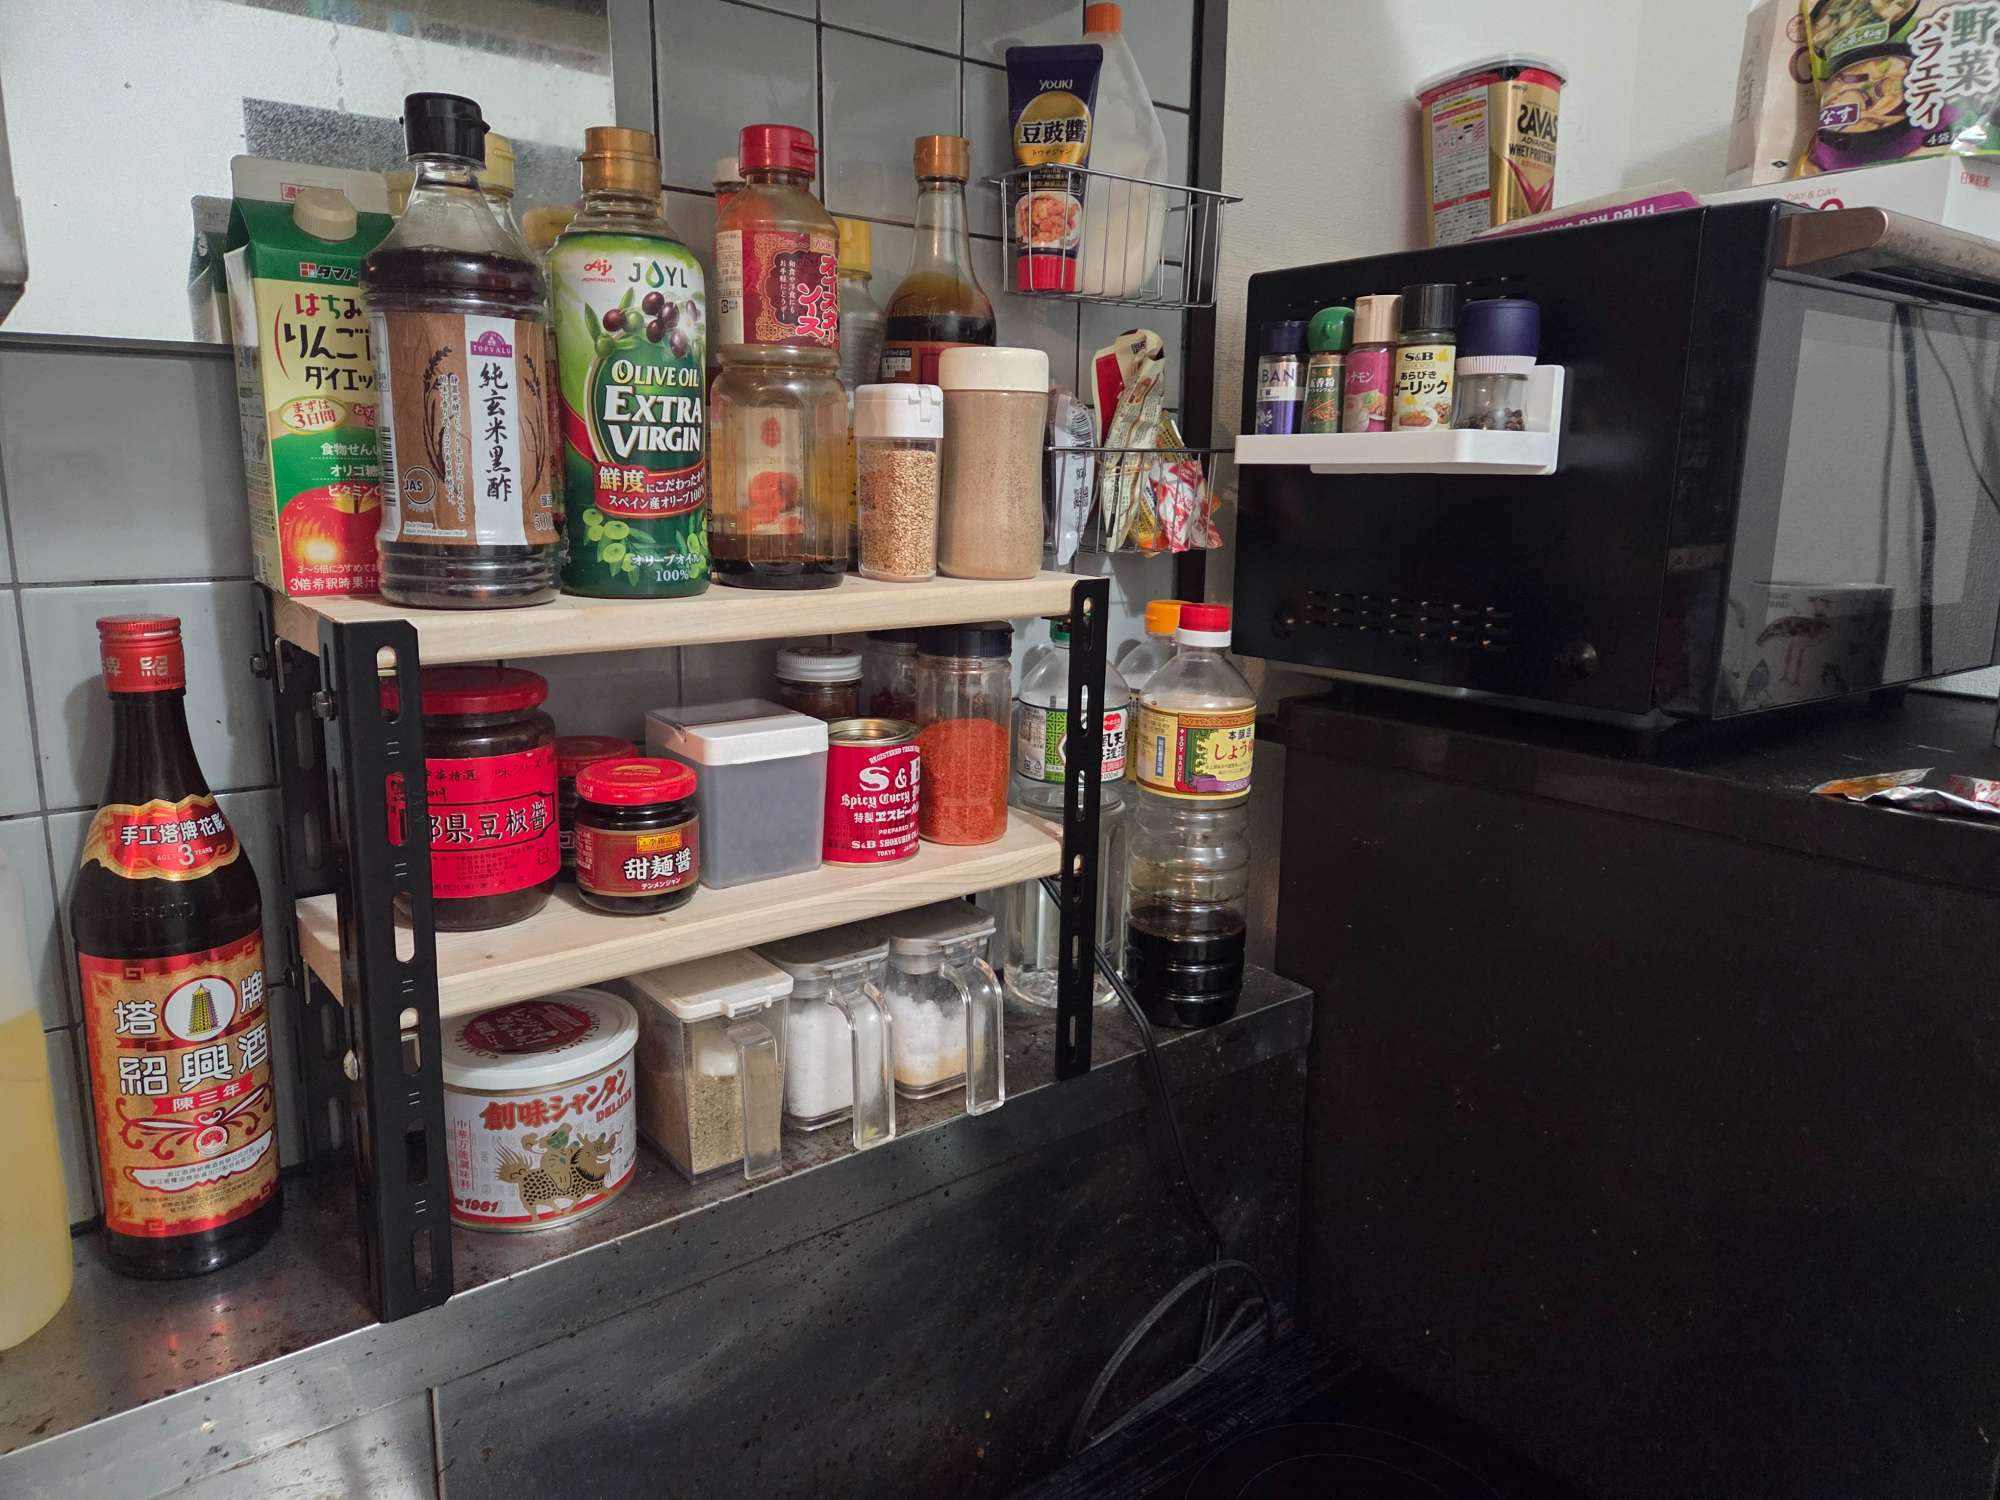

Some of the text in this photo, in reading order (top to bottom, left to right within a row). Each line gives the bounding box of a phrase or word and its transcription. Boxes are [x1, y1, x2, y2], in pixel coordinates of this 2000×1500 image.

[1039, 79, 1073, 91] YOUKI
[611, 359, 699, 388] OLIVE OIL
[602, 384, 702, 425] EXTRA
[478, 361, 513, 503] 純玄米黒酢
[607, 424, 701, 459] VIRGIN
[404, 480, 422, 491] JAS
[655, 569, 689, 582] 100%
[859, 766, 890, 792] S
[841, 793, 877, 809] Spicy
[879, 790, 910, 805] Curry
[878, 825, 908, 835] PREPARED
[178, 843, 195, 866] 3
[851, 840, 876, 849] S&B
[877, 849, 896, 857] TOKYO
[641, 877, 682, 890] テンメンジャン
[118, 1022, 268, 1096] 紹興酒
[172, 1082, 242, 1112] 陳三年
